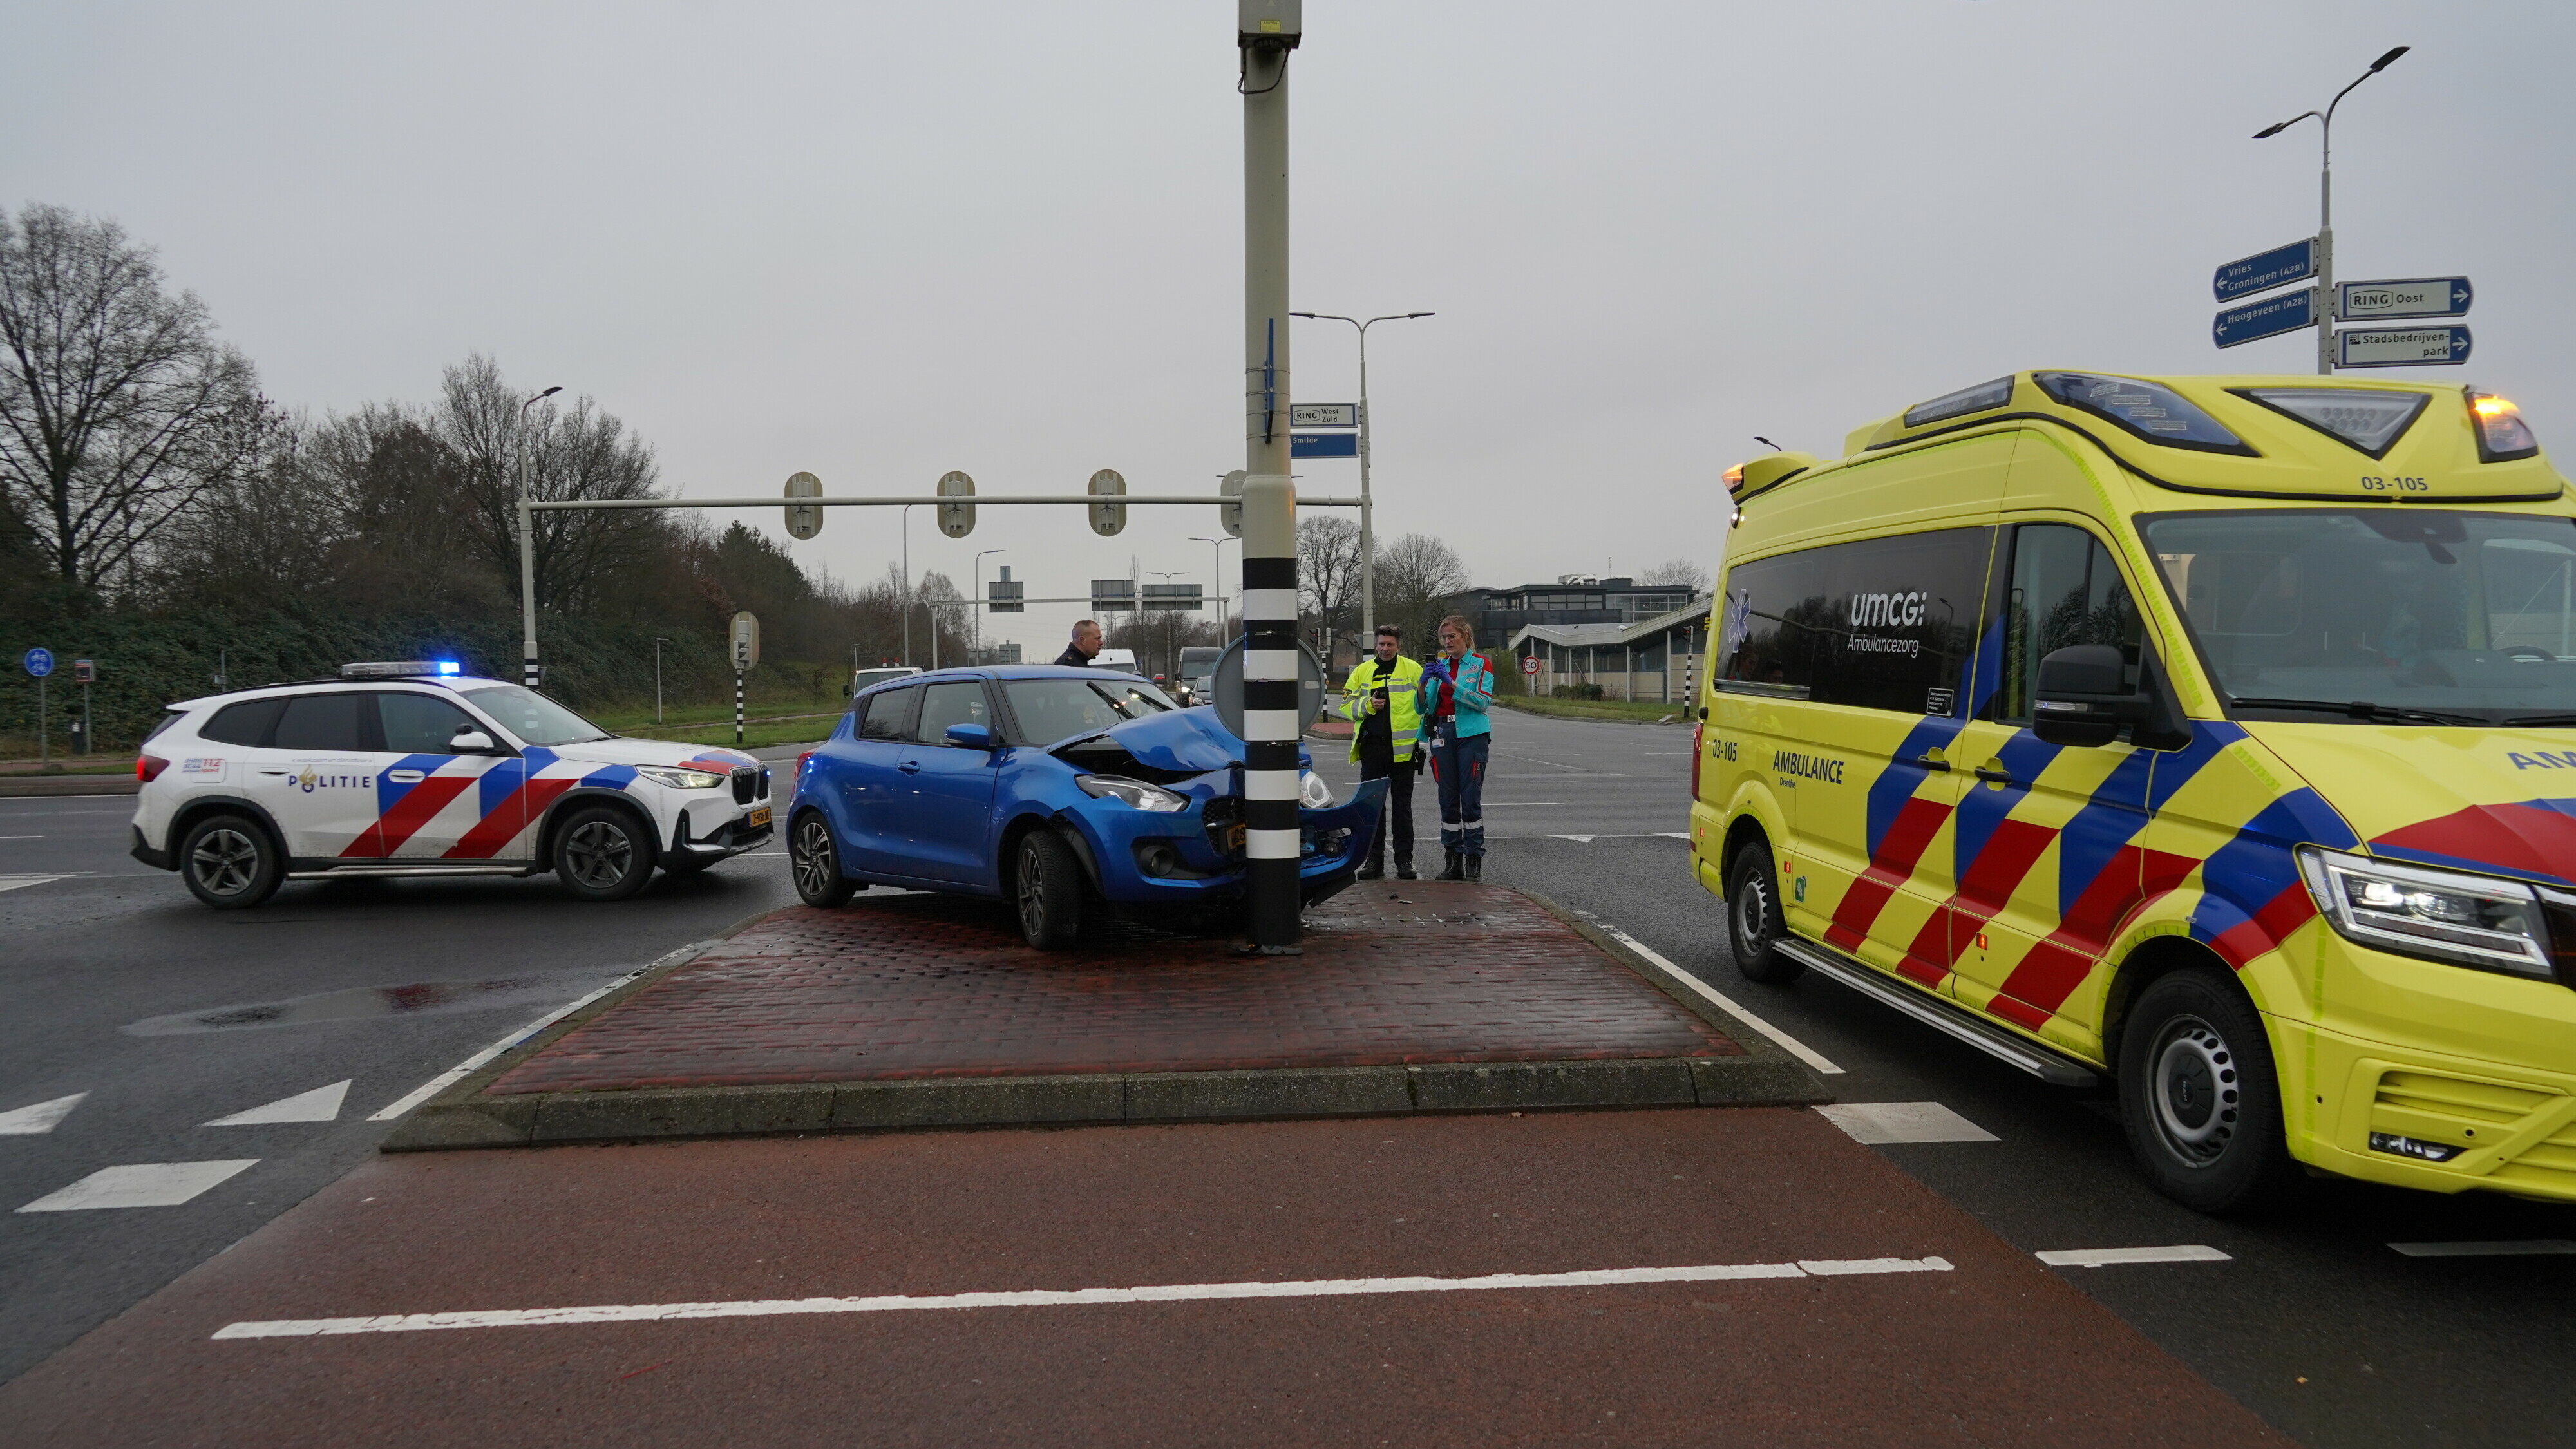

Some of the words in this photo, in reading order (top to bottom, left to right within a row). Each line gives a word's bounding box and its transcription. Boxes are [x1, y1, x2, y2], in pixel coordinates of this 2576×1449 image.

[2228, 264, 2251, 277] Vries
[2228, 271, 2277, 291] Groningen
[2280, 261, 2304, 277] (A28)
[2354, 294, 2388, 305] RING
[2396, 294, 2424, 303] Oost
[2228, 303, 2280, 323] Hoogeveen
[2283, 295, 2307, 309] (A28)
[2363, 333, 2450, 344] Stadsbedrijven-
[2423, 346, 2449, 358] park
[2362, 477, 2428, 490] 03-105
[1847, 634, 1919, 658] Ambulancezorg
[1712, 739, 1738, 762] 03-105
[1773, 750, 1844, 784] AMBULANCE
[288, 775, 371, 793] POLITIE
[1779, 777, 1796, 789] Drenthe
